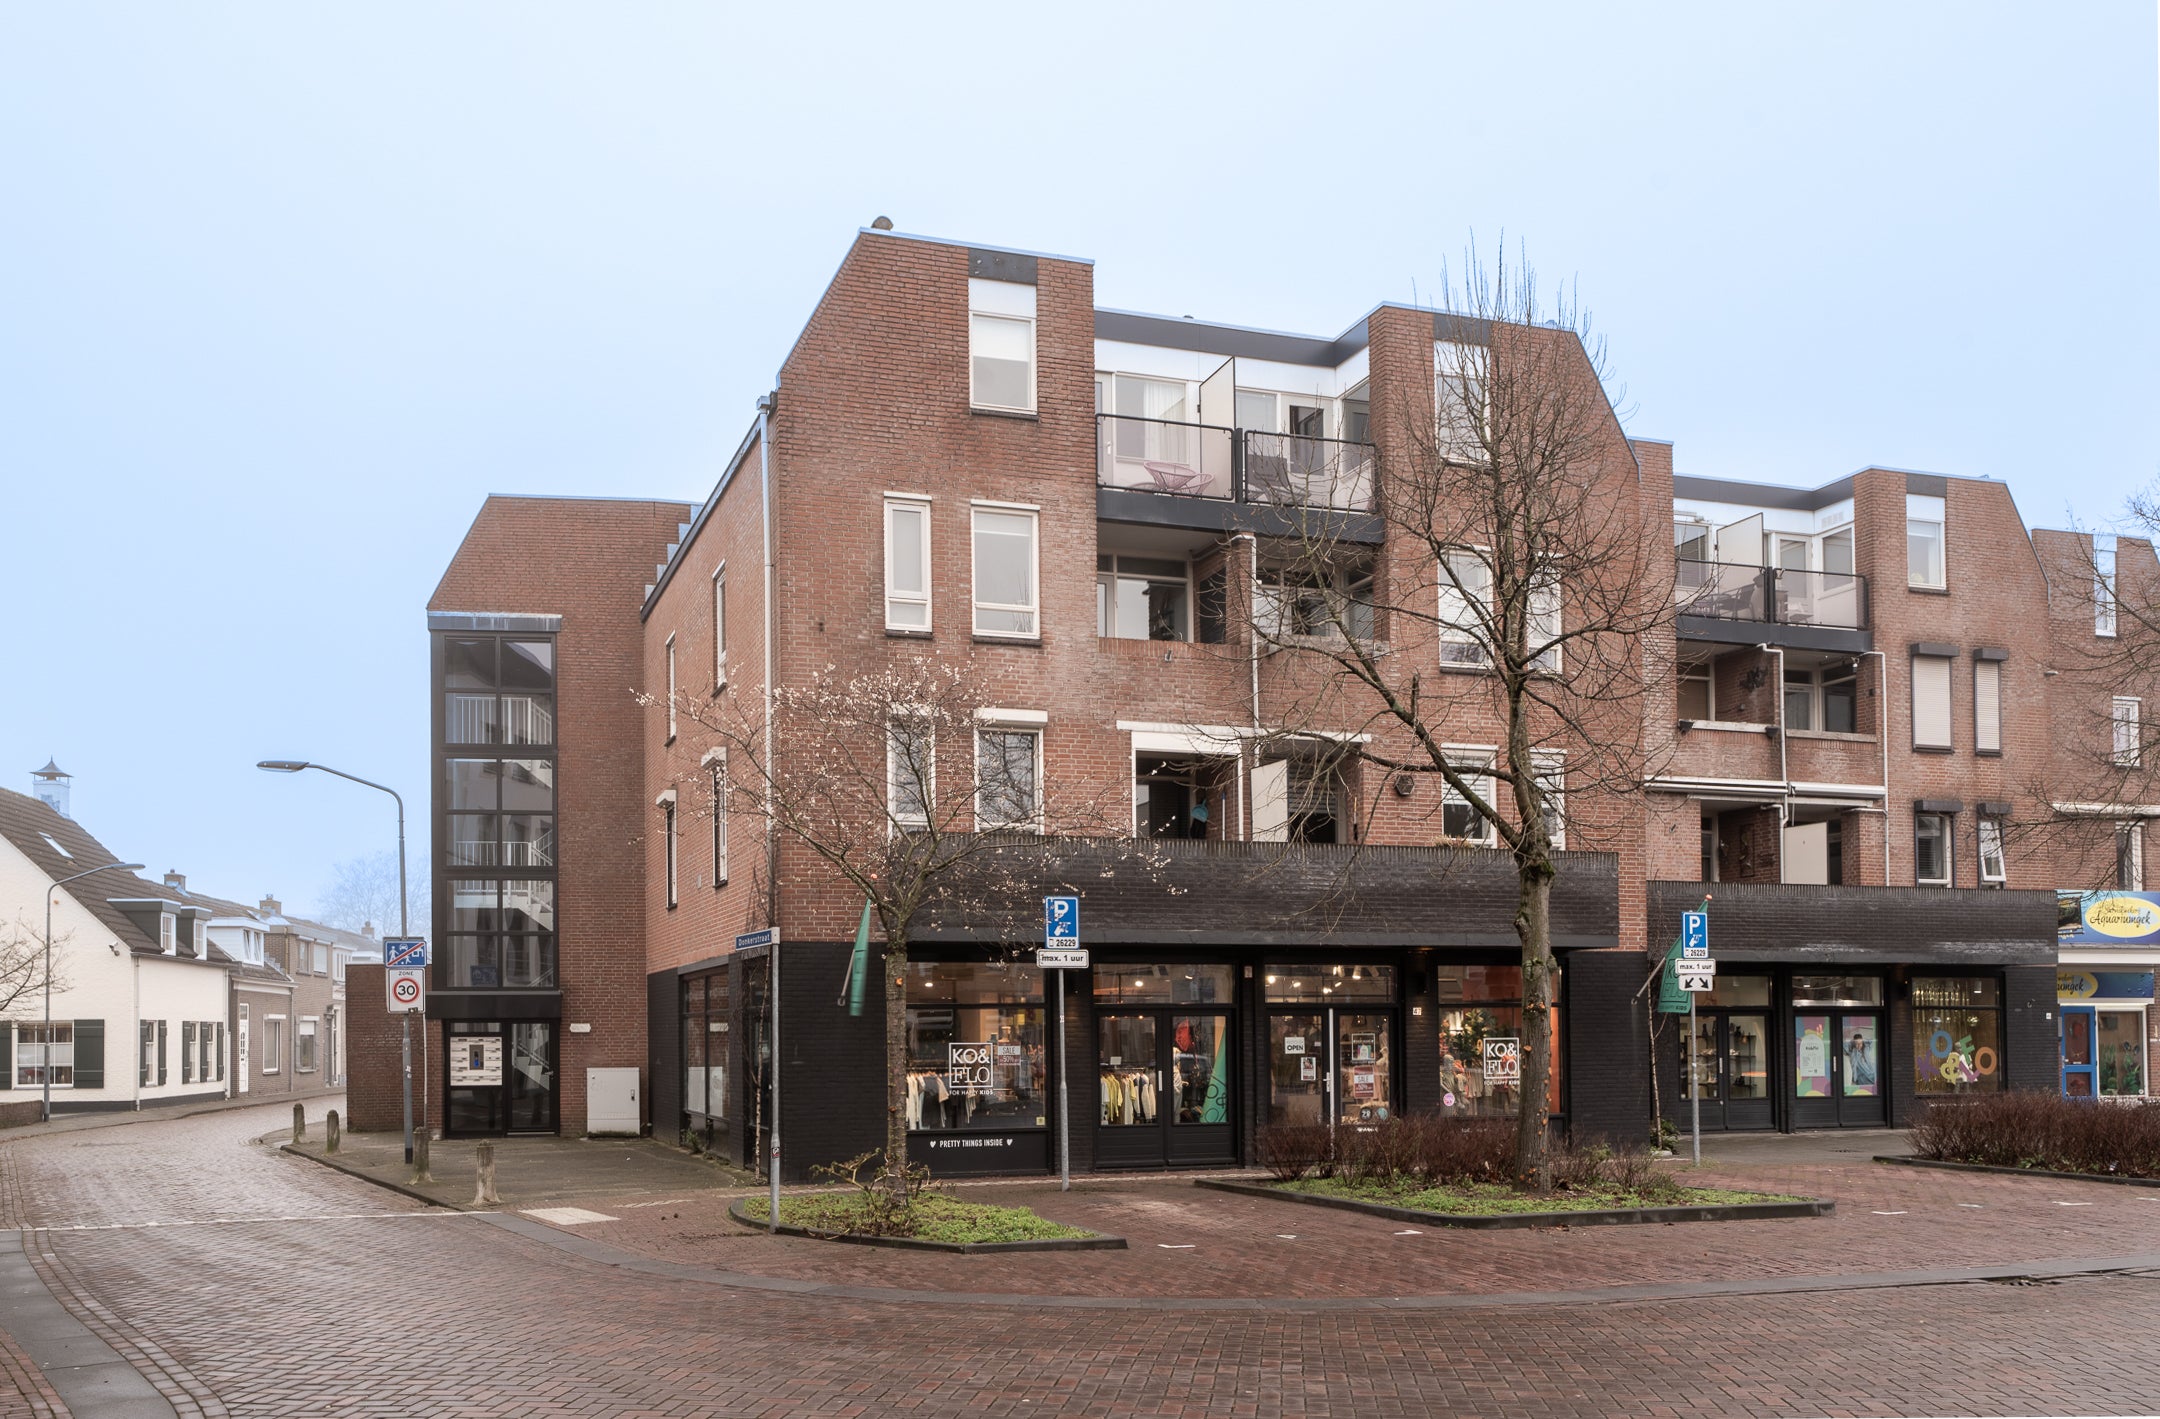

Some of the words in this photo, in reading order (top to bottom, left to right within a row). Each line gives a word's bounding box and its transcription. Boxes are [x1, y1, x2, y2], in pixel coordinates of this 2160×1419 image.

[1688, 915, 1701, 935] P
[1055, 939, 1077, 947] 26229
[1063, 954, 1068, 962] 1
[1690, 949, 1706, 957] 26229
[397, 984, 416, 996] 30
[1002, 1047, 1016, 1055] SALE
[1486, 1042, 1517, 1057] KO&
[952, 1048, 991, 1064] KO&
[1486, 1059, 1517, 1075] FLO
[952, 1066, 990, 1083] FLO
[939, 1139, 961, 1148] PRETTY
[962, 1138, 983, 1148] THINGS
[983, 1138, 1004, 1147] INSIDE
